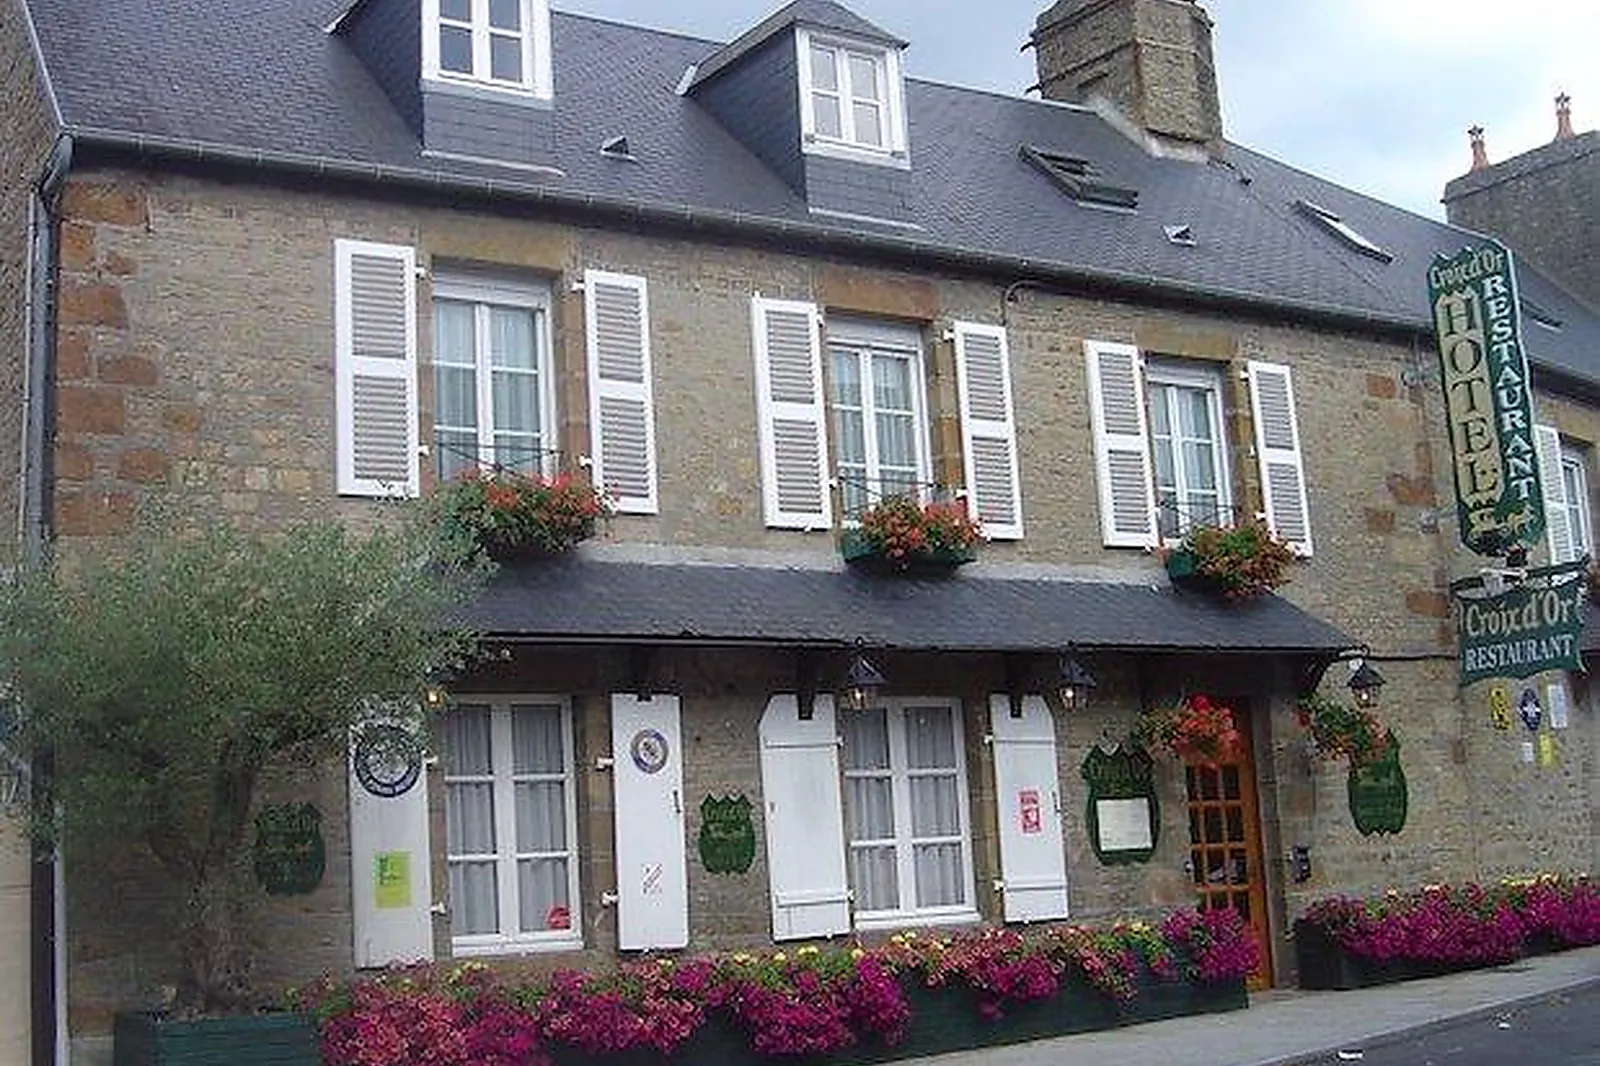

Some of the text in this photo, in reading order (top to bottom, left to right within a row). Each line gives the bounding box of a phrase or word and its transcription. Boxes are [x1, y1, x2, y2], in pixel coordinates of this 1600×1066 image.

[1443, 297, 1498, 495] HOTEL
[1482, 274, 1535, 501] RESTAURANT
[1465, 634, 1575, 672] RESTAURANT
[1466, 589, 1575, 637] Croix d'Or
